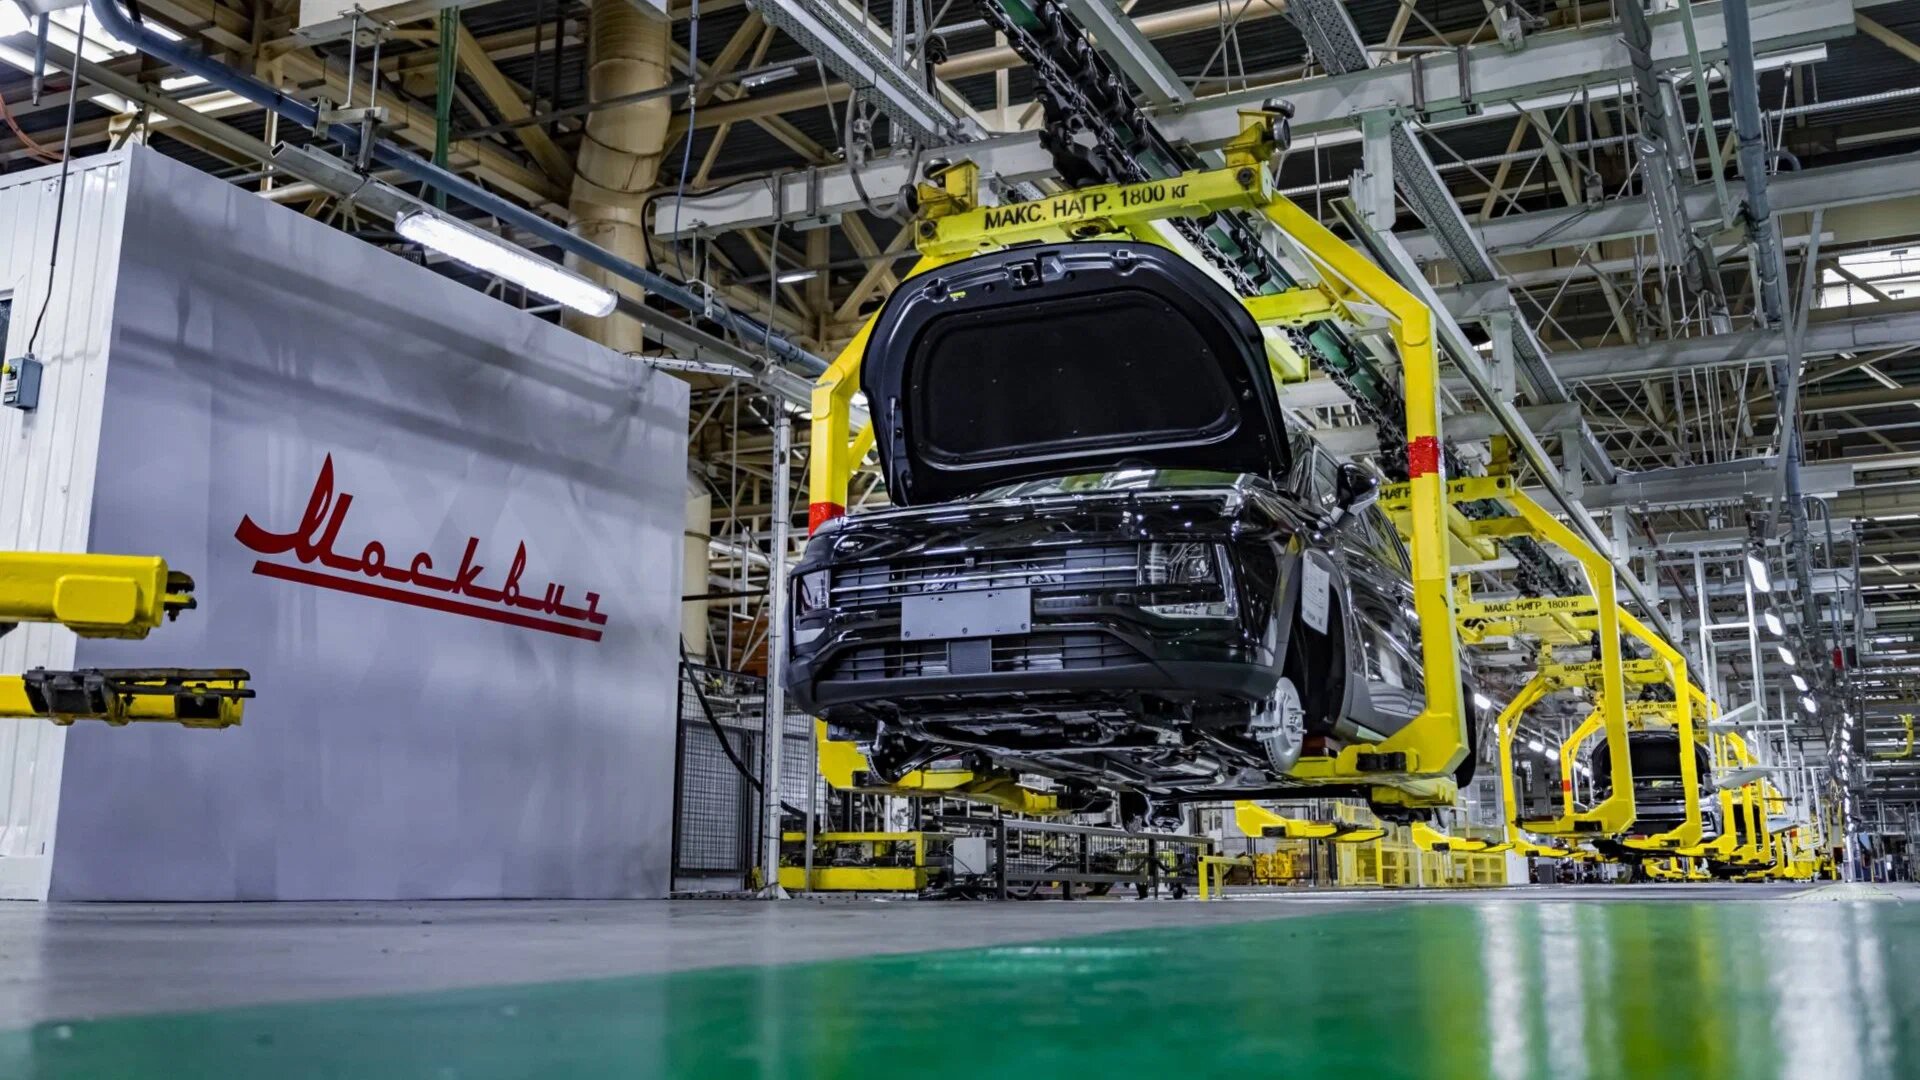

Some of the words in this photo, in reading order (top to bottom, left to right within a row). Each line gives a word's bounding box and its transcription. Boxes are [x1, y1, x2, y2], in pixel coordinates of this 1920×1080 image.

[985, 203, 1046, 230] МАКС.
[1053, 193, 1111, 218] НАГР.
[1120, 185, 1166, 207] 1800
[1171, 184, 1189, 199] кг
[1547, 600, 1569, 608] 1800
